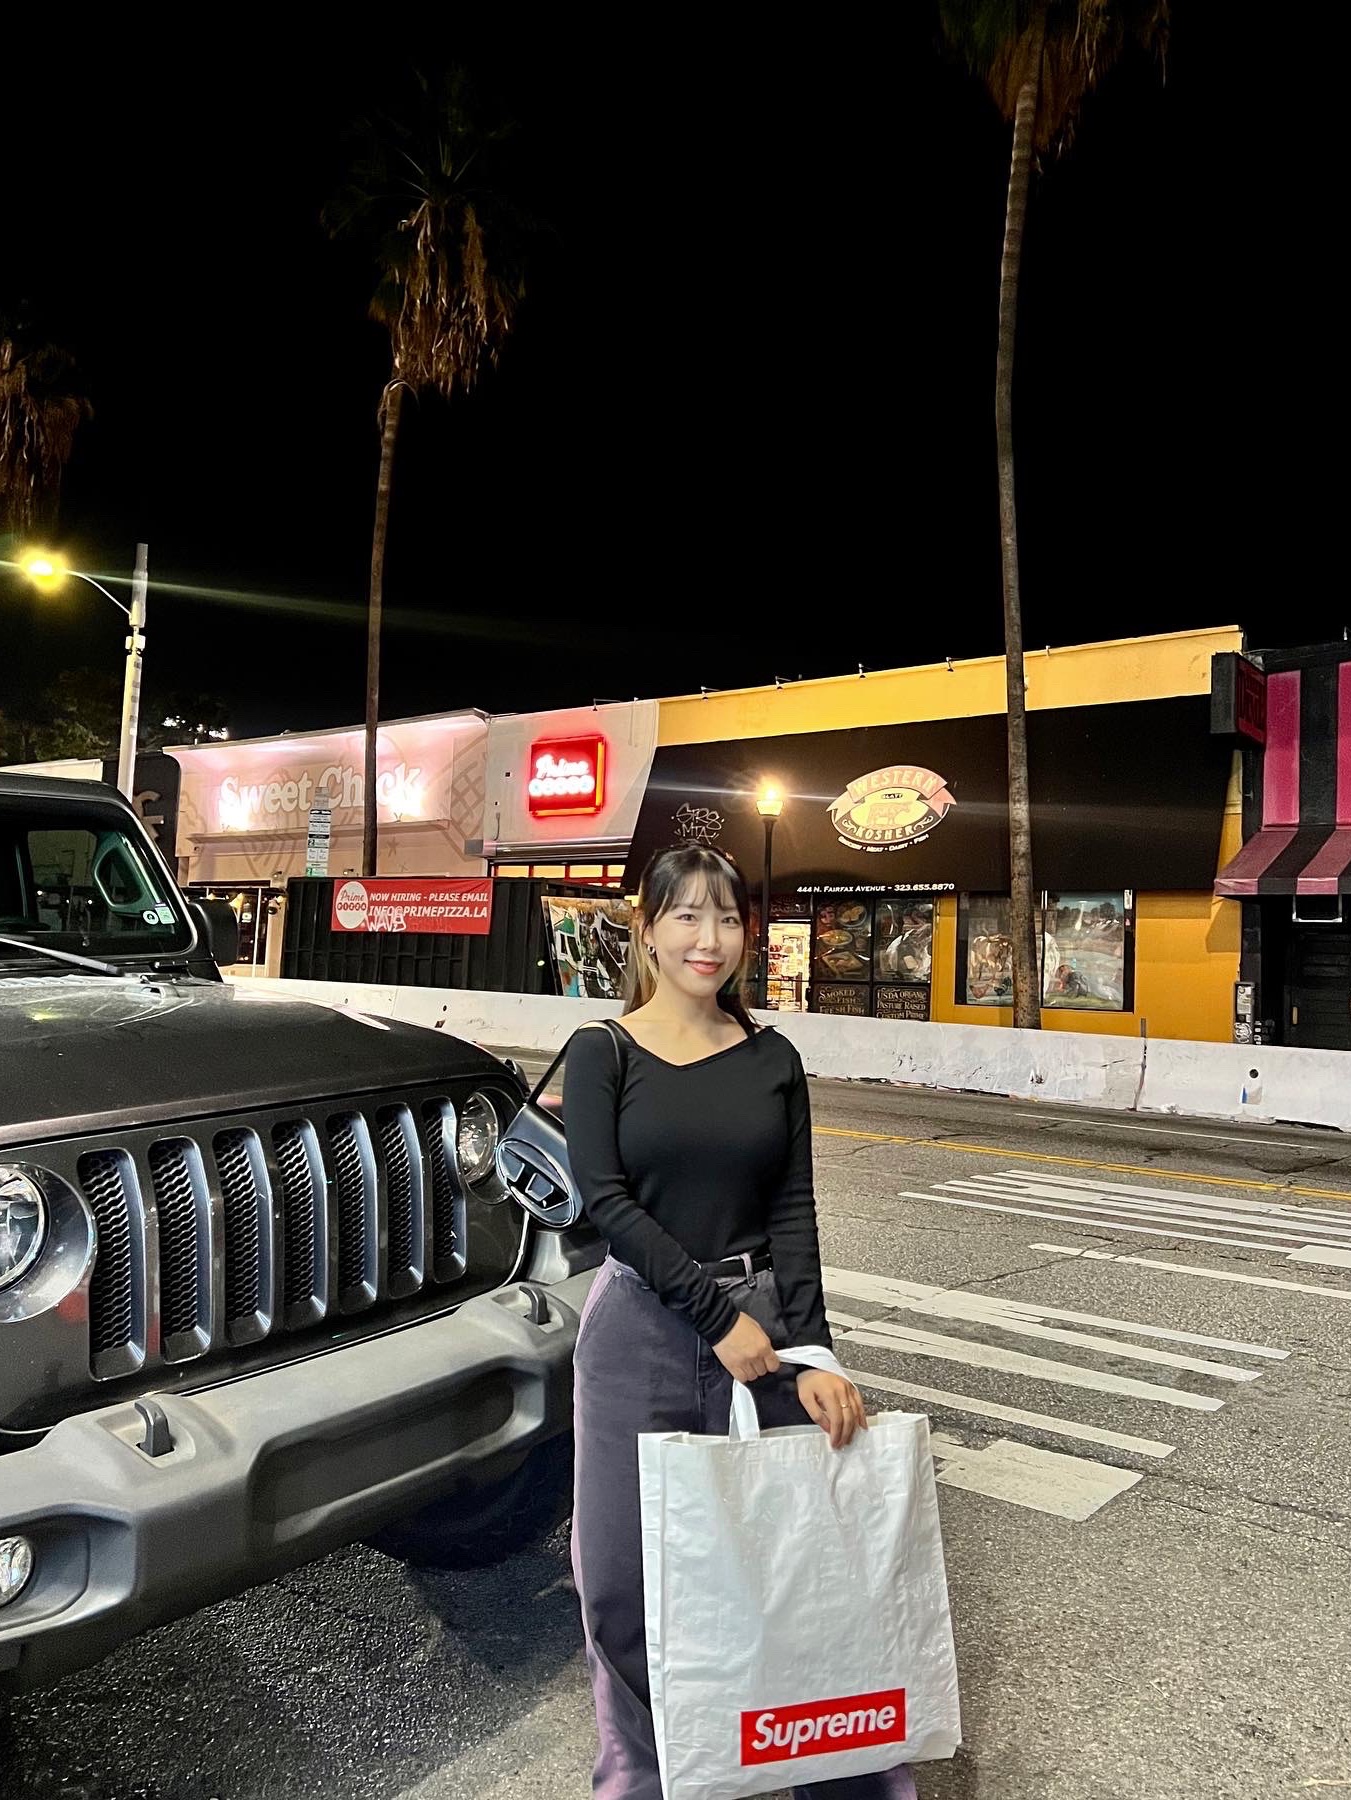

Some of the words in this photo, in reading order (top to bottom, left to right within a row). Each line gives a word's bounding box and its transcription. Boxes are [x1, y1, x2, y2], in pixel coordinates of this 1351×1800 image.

[219, 771, 312, 814] Sweet
[319, 762, 421, 811] Chck
[851, 769, 939, 794] WESTERN
[855, 825, 915, 841] KOSHER
[813, 885, 822, 893] N.
[370, 893, 389, 901] NOW
[391, 893, 422, 901] HIRING
[429, 893, 461, 901] PLEASE
[462, 893, 488, 902] EMAIL
[368, 905, 488, 918] INFO@PRIMEPIZZA.LA
[819, 988, 856, 999] SMOKED
[877, 991, 899, 1000] USDA
[751, 1705, 897, 1755] Supreme
